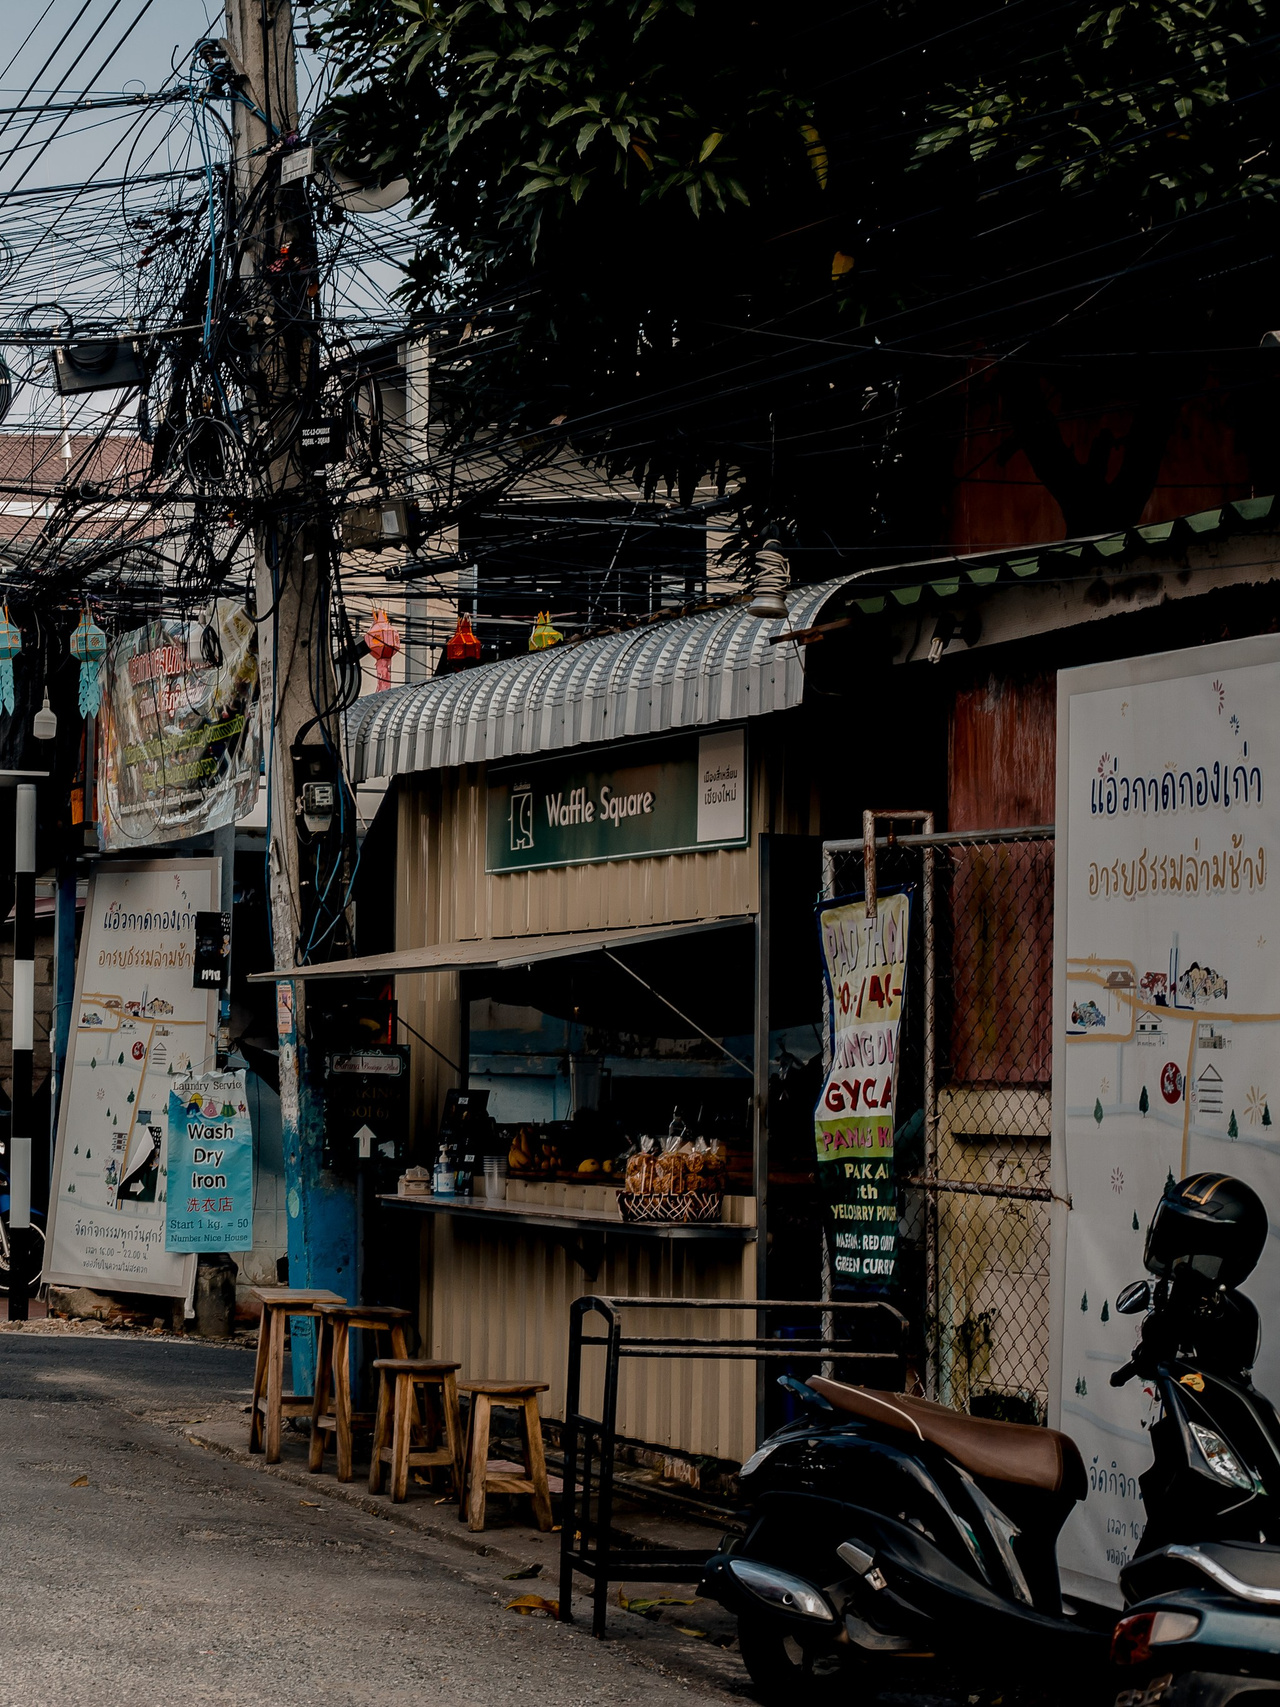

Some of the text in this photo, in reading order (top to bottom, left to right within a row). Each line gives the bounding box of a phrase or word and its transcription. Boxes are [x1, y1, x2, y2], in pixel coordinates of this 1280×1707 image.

[1091, 741, 1262, 814] แอ่วกาดกองเก่า
[704, 782, 737, 805] เชียงใหม่
[545, 785, 654, 828] Waffle Square
[1089, 833, 1265, 896] อารยธรรมล่ามช้าง
[826, 910, 905, 977] PAD THAI
[173, 1082, 210, 1092] Laundry
[187, 1122, 234, 1140] Wash
[194, 1148, 224, 1167] Dry
[193, 1173, 226, 1188] Iron
[186, 1196, 234, 1212] 洗衣店
[170, 1219, 195, 1229] Start
[198, 1219, 203, 1229] 1
[207, 1218, 224, 1231] kg.
[237, 1218, 249, 1229] 50
[170, 1233, 248, 1243] Number Nice House
[862, 1234, 880, 1250] RED
[85, 1246, 98, 1256] เวลา
[100, 1247, 114, 1257] 16.00
[123, 1249, 140, 1260] 22.00
[835, 1255, 895, 1276] GREEN CURRY
[1089, 1455, 1144, 1500] จัดกิจก
[1107, 1518, 1127, 1537] เวลา
